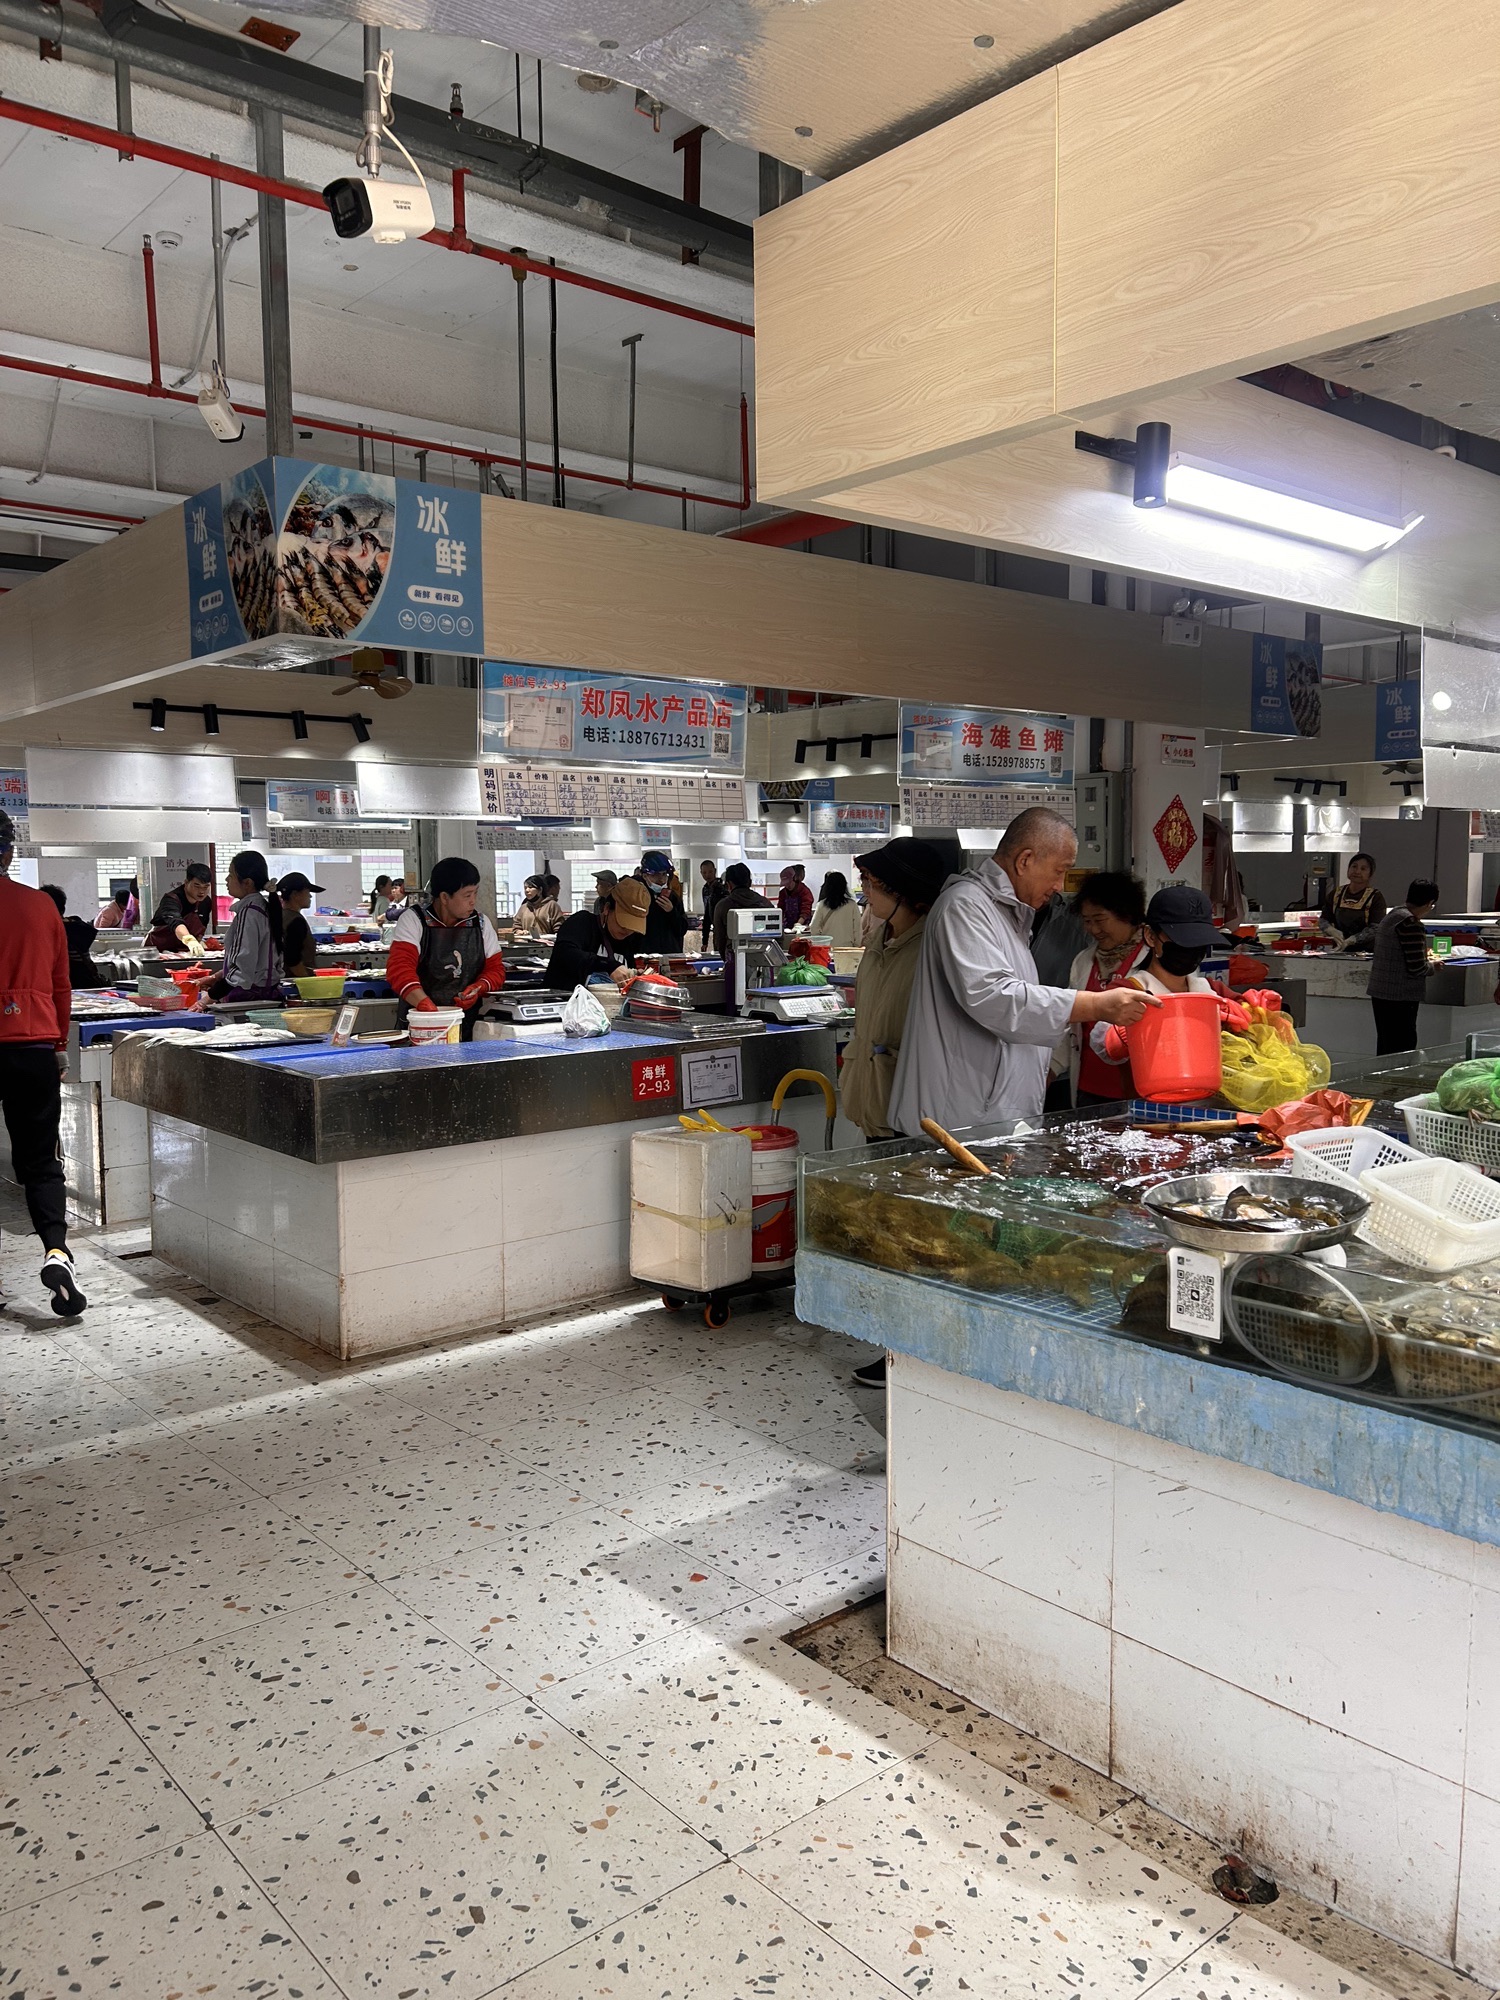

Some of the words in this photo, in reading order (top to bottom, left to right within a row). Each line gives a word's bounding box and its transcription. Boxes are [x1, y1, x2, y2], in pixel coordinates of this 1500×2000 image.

[192, 506, 217, 580] 冰鲜
[416, 495, 467, 577] 冰鲜
[414, 589, 431, 599] 新鲜
[435, 592, 460, 603] 看得见
[503, 673, 567, 691] 摊位号:2-93
[580, 686, 733, 729] 郑凤水产品店
[1385, 687, 1412, 724] 冰鲜
[583, 725, 706, 749] 电话:18876713431
[961, 722, 1065, 753] 海雄鱼摊
[962, 752, 1046, 770] 电话:15289788575
[484, 768, 498, 813] 明码标价
[562, 774, 576, 782] 品名
[586, 775, 600, 783] 价格
[613, 776, 626, 784] 品名
[636, 777, 649, 785] 价格
[705, 780, 717, 788] 品名
[725, 781, 738, 789] 价格
[642, 1064, 666, 1080] 海鲜
[639, 1079, 670, 1095] 2-93
